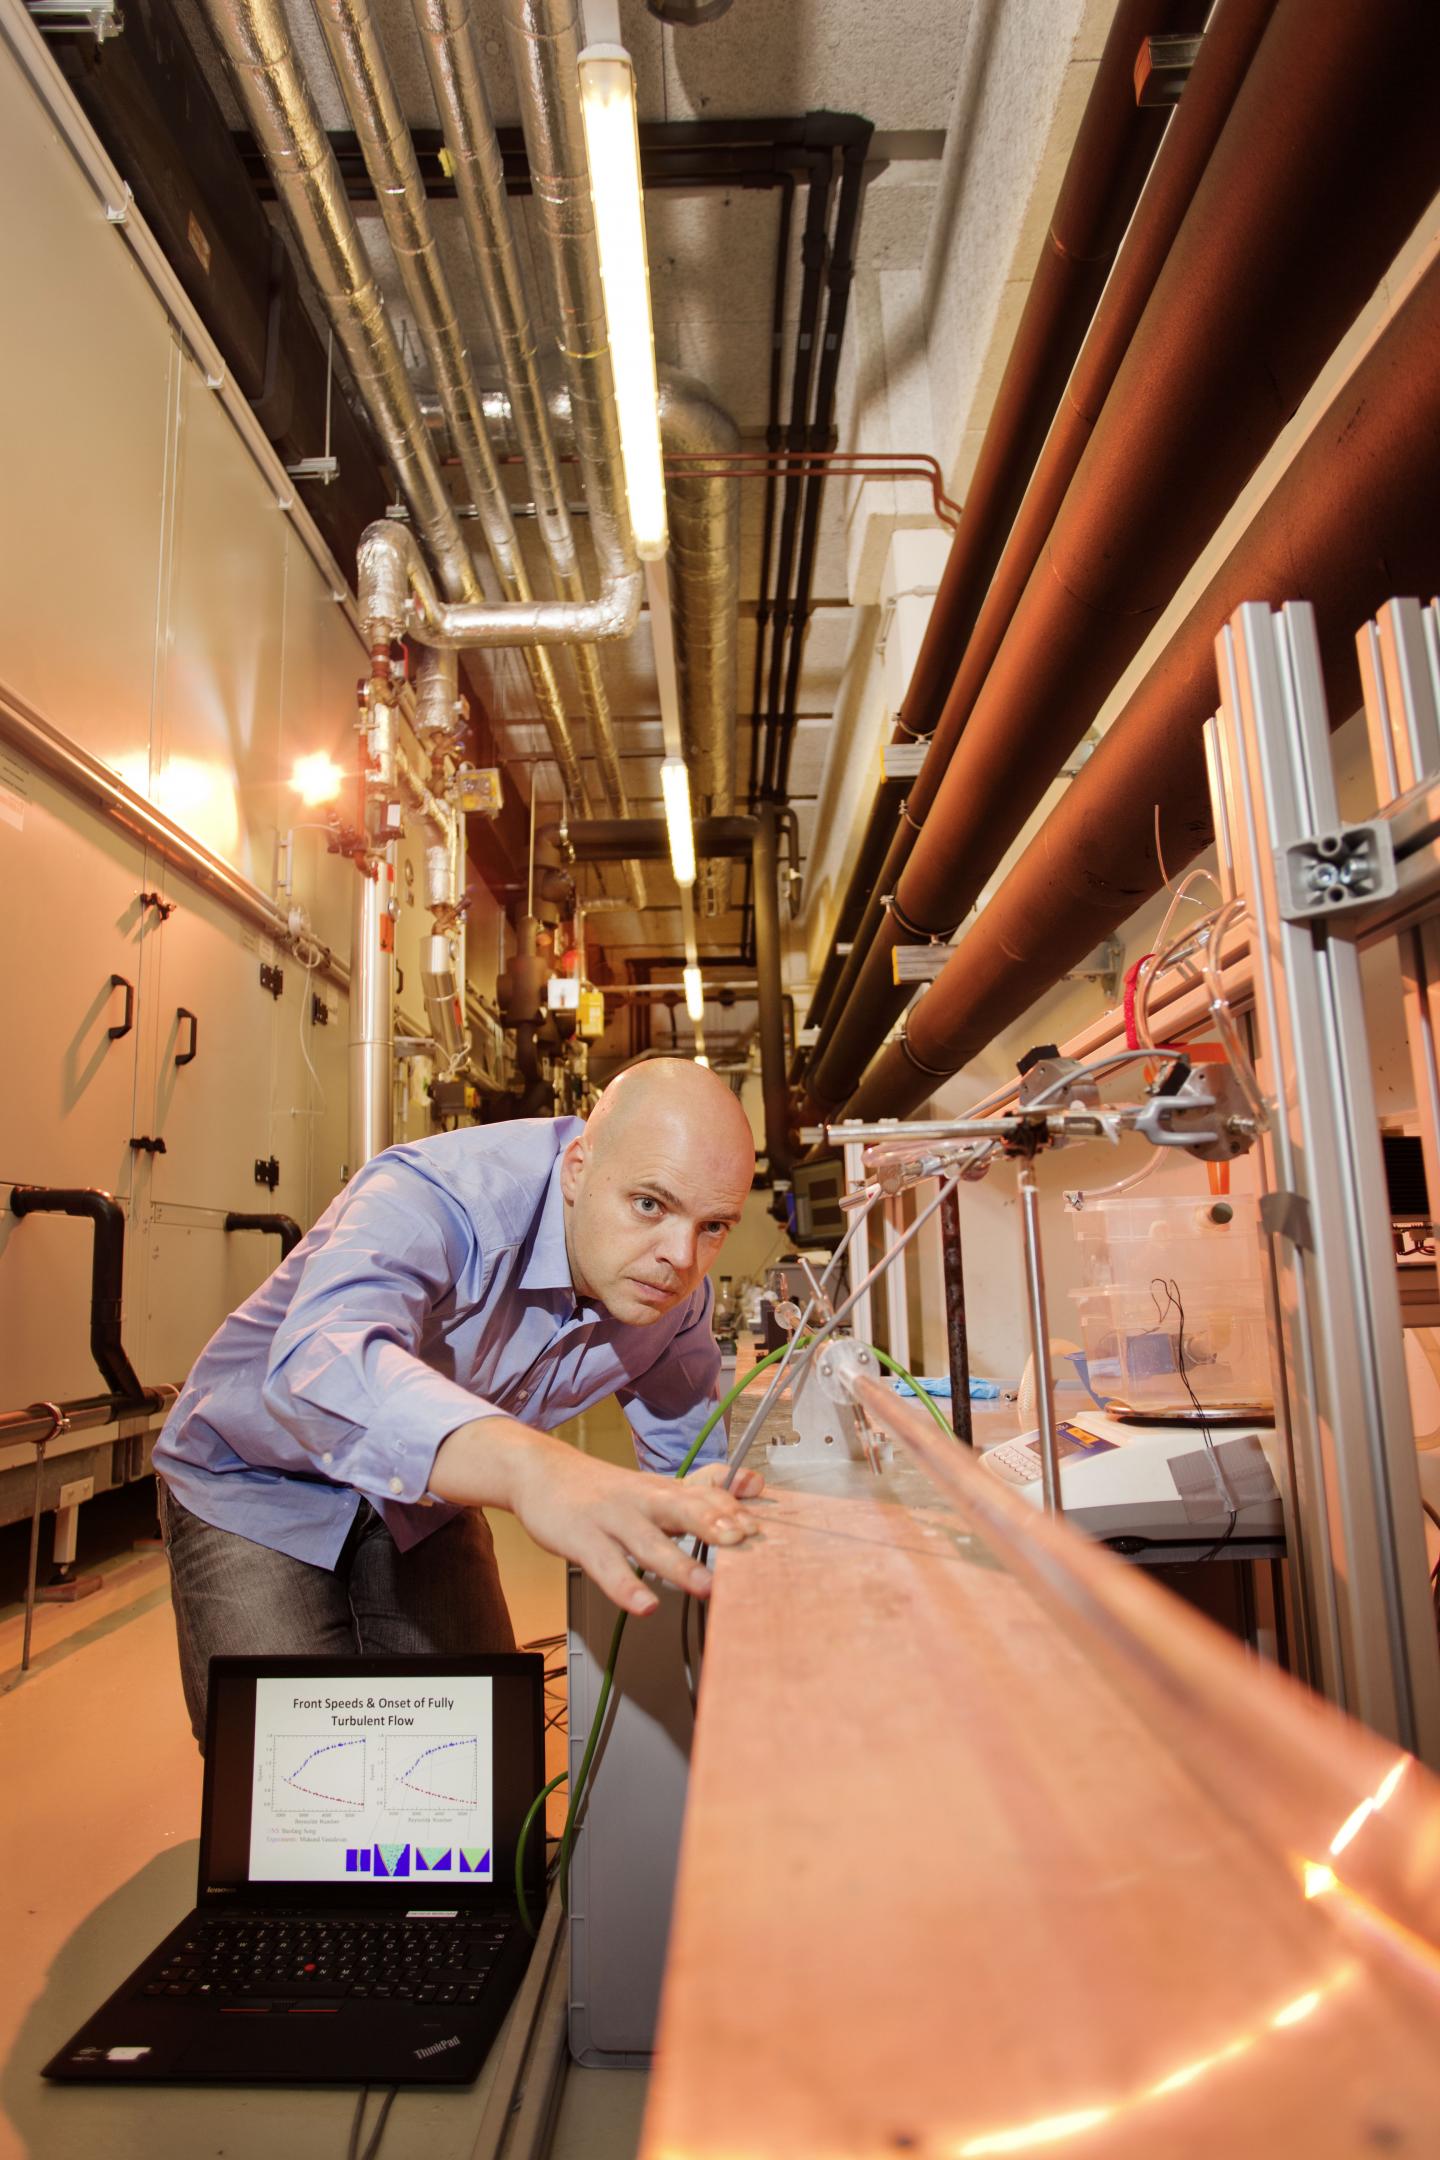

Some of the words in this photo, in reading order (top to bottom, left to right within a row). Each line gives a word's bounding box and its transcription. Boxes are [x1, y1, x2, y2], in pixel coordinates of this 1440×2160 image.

[293, 1698, 322, 1709] Front
[325, 1698, 364, 1711] Speeds
[366, 1698, 375, 1709] &
[378, 1698, 411, 1709] Onset
[413, 1697, 426, 1709] of
[428, 1697, 455, 1710] Fully
[331, 1715, 385, 1726] Turbulent
[388, 1715, 415, 1726] Flow
[413, 2035, 461, 2060] ThinkPad
